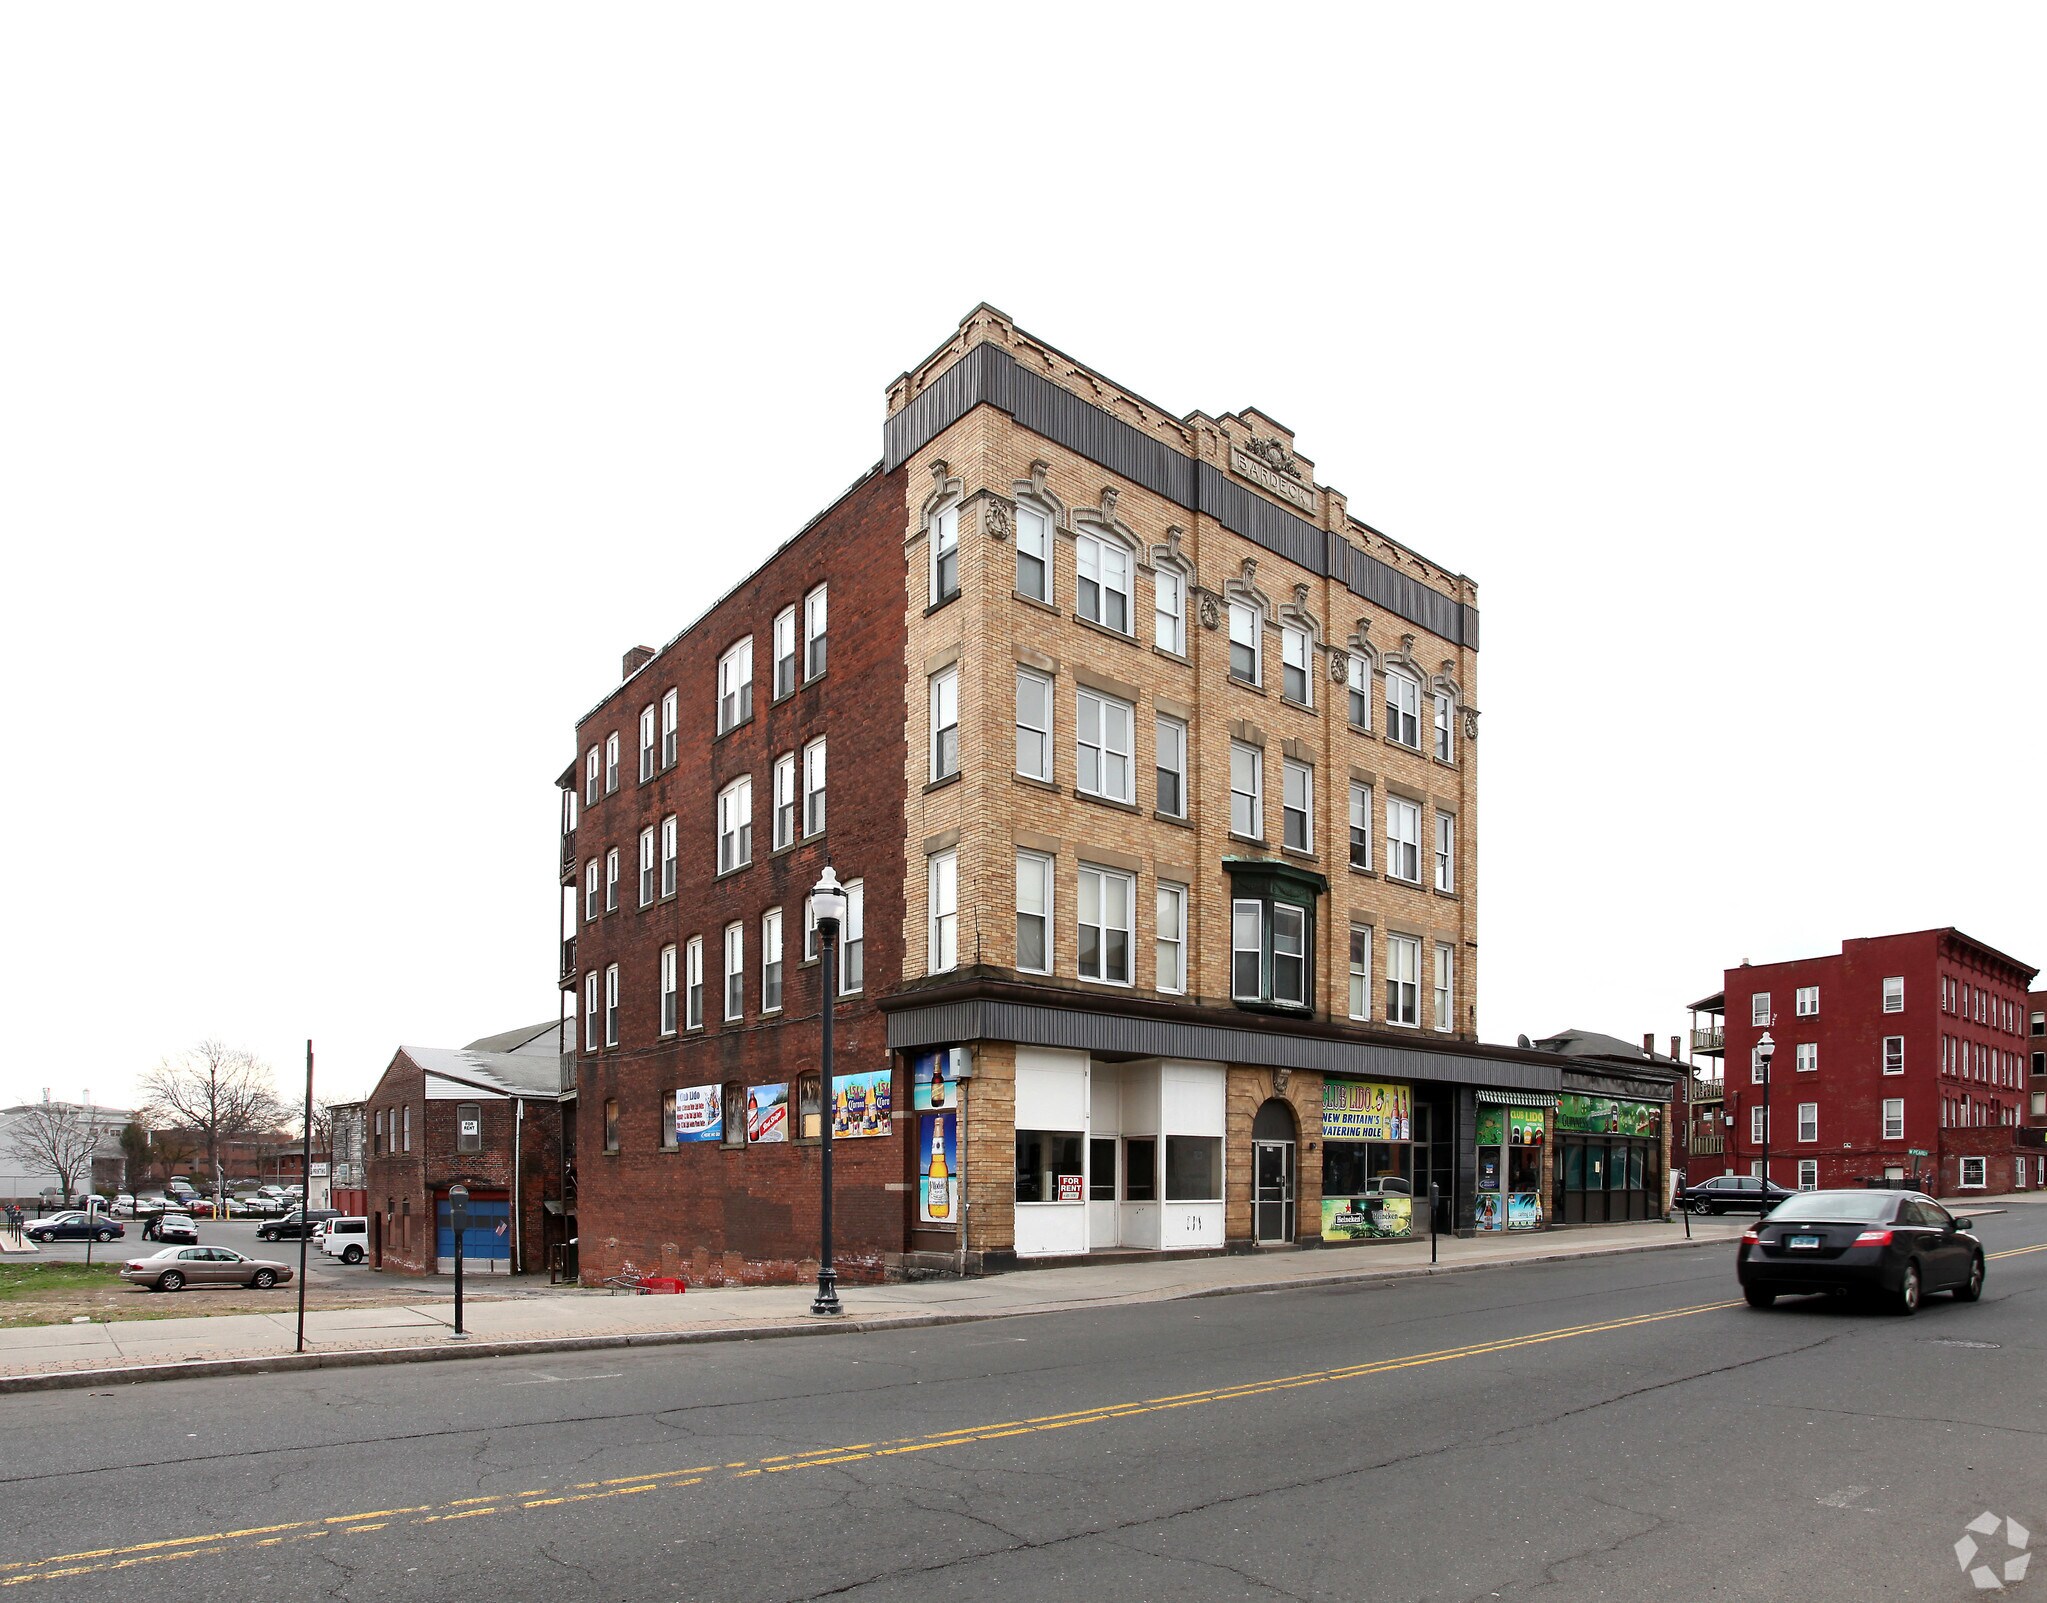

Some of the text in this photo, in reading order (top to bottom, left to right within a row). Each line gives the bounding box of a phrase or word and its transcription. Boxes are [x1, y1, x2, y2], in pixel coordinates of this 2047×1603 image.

[1323, 1085, 1372, 1112] CLUB LIDO
[849, 1100, 865, 1111] Corona
[1323, 1112, 1380, 1125] NEW BRITAIN'S
[1510, 1110, 1544, 1123] CLUB LIDO
[1363, 1127, 1382, 1138] HOLE
[1336, 1215, 1361, 1223] Heineken
